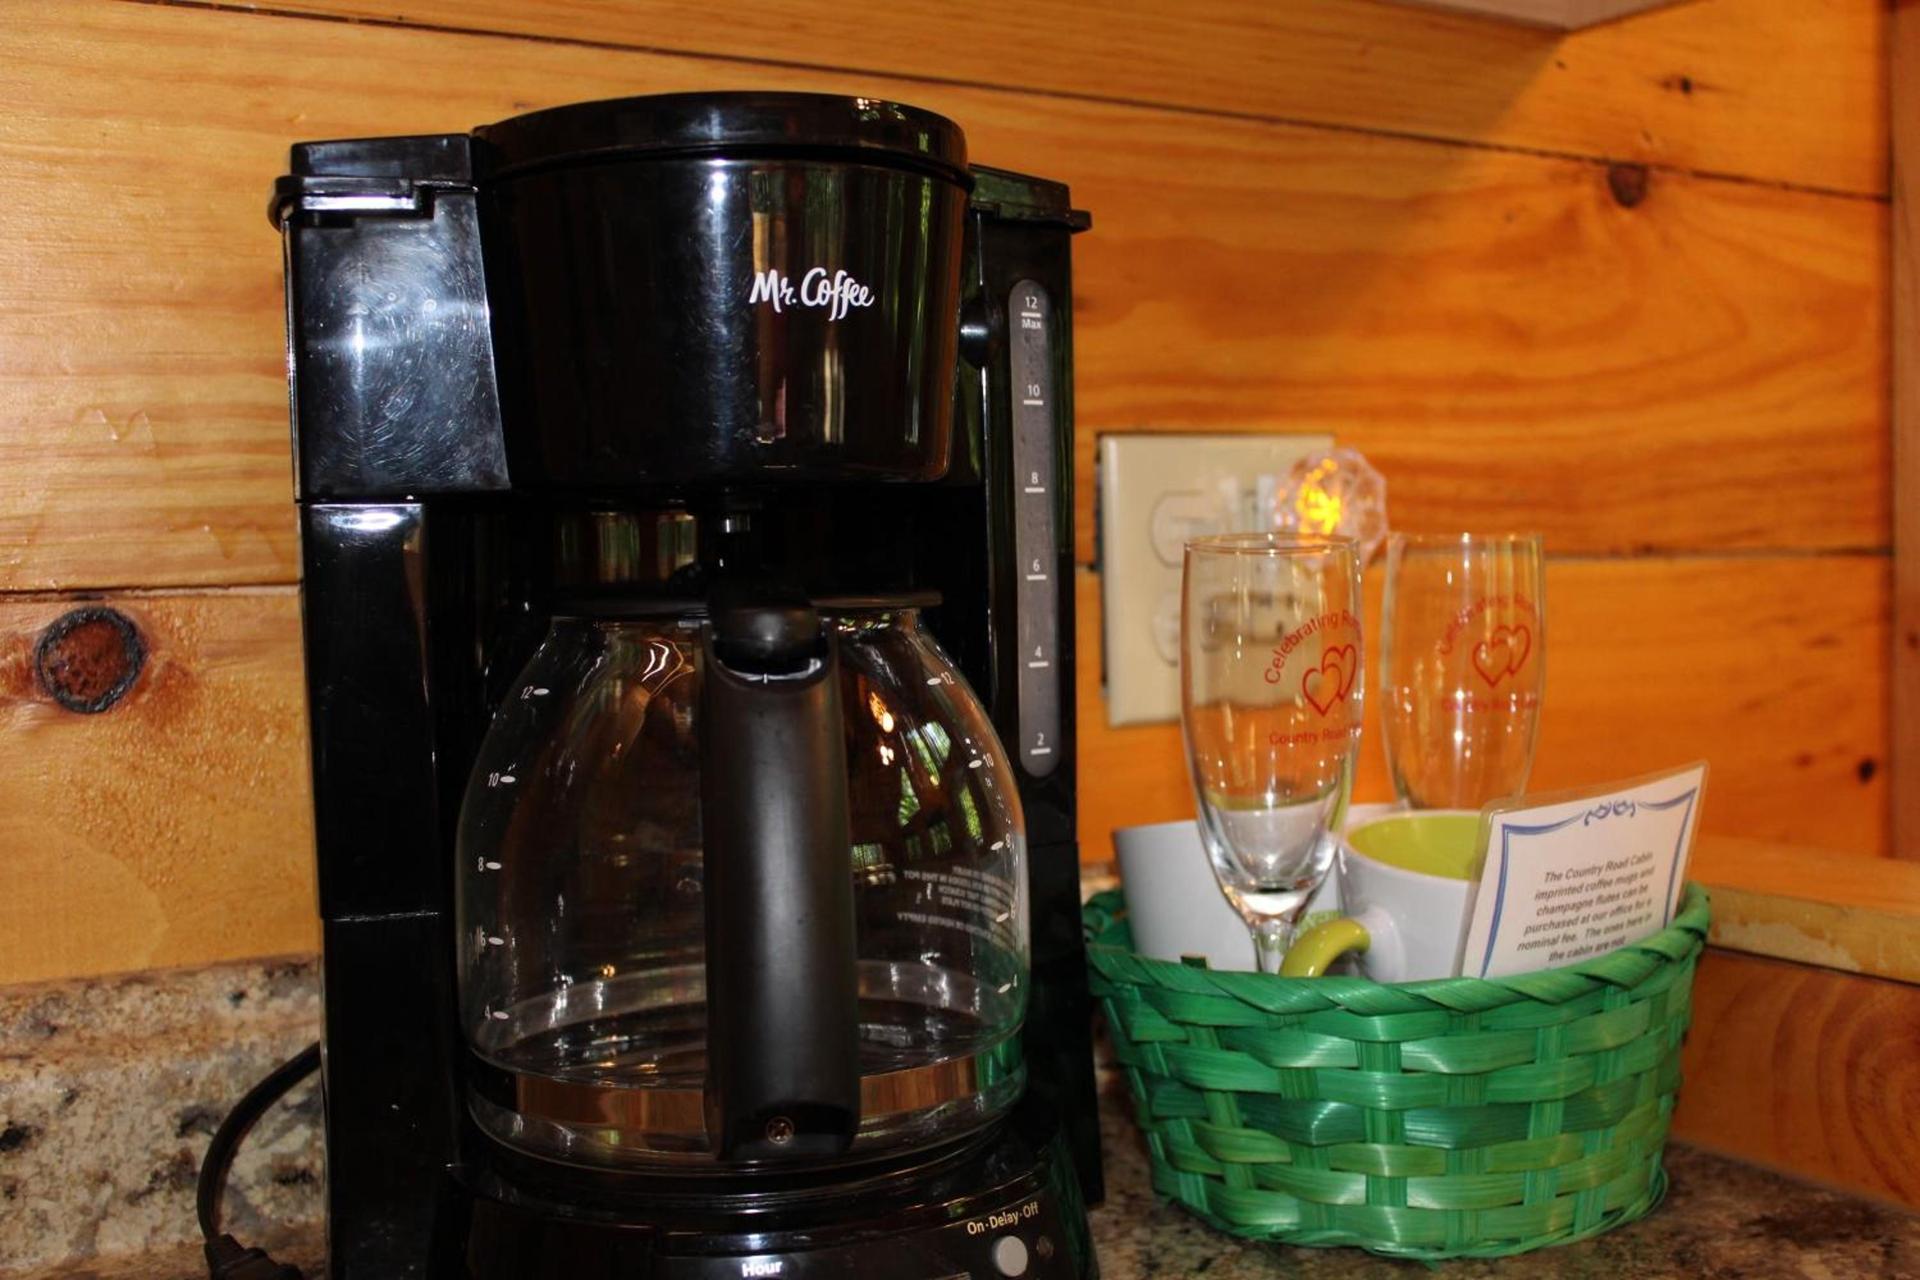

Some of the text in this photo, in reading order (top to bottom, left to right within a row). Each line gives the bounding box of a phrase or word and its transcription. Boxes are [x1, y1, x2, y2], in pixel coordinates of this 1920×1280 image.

[749, 267, 874, 321] Mr. Coffee
[1025, 296, 1038, 309] 12
[1021, 319, 1042, 330] Max
[1027, 384, 1041, 397] 10
[1031, 472, 1039, 484] 8
[1033, 559, 1040, 572] 6
[1035, 646, 1042, 658] 4
[1264, 612, 1340, 684] Celebrating
[941, 671, 955, 685] 12
[519, 685, 535, 699] 12
[1037, 733, 1045, 746] 2
[488, 772, 499, 787] 10
[478, 856, 484, 872] 8
[1544, 871, 1563, 884] The
[1565, 865, 1604, 880] Country
[1605, 857, 1629, 872] Road
[1534, 883, 1584, 901] imprinted
[1584, 878, 1613, 893] coffee
[1615, 872, 1638, 885] mugs
[1536, 883, 1649, 917] champagne flutes can be
[1523, 915, 1580, 937] purchased
[1580, 913, 1591, 924] at
[1591, 911, 1608, 922] our
[1609, 904, 1633, 918] office
[1516, 934, 1560, 951] nominal
[1585, 927, 1602, 938] The
[1603, 922, 1624, 935] ones
[1626, 916, 1643, 928] here
[1548, 935, 1626, 962] the cabin are not
[484, 1004, 491, 1021] 4
[741, 1261, 783, 1278] Hour
